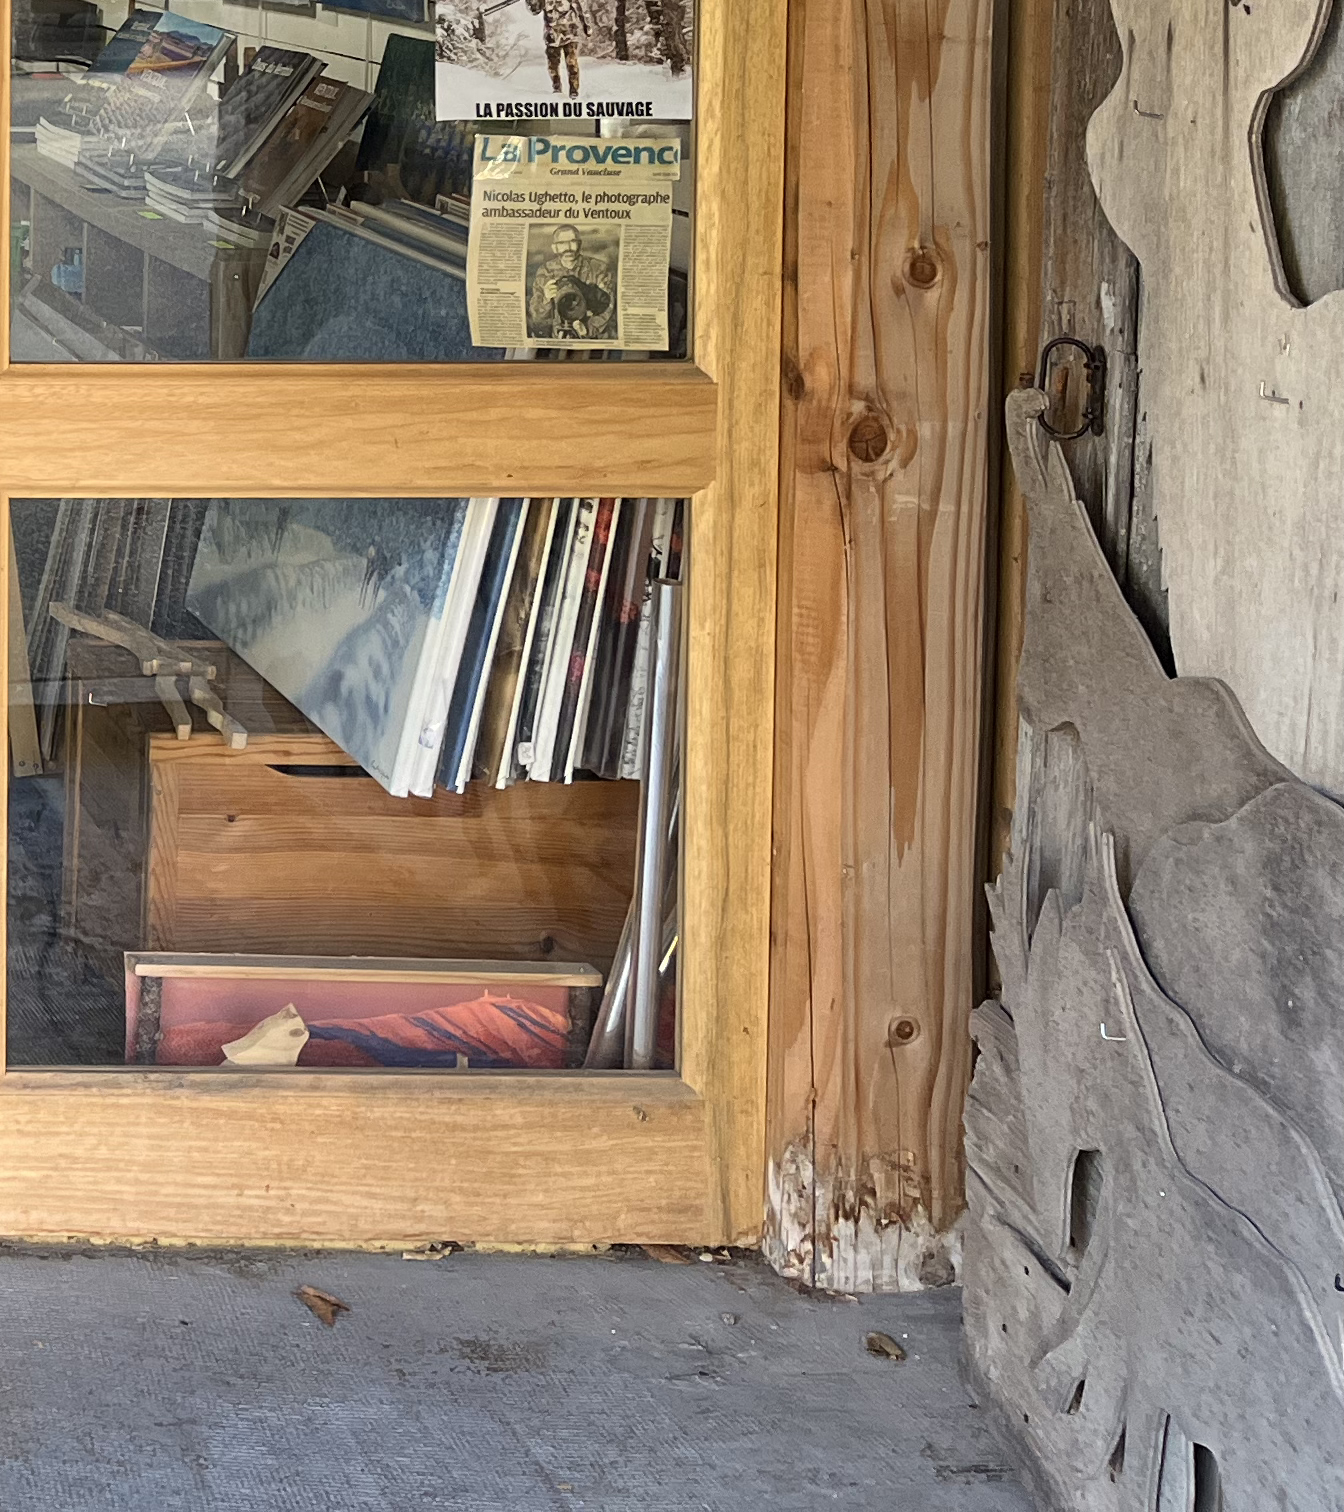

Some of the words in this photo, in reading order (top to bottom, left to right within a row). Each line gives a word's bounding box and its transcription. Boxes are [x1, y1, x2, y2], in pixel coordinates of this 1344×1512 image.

[476, 103, 492, 118] LA
[496, 102, 559, 118] PASSION
[562, 102, 583, 117] DU
[586, 101, 653, 117] SAUVAGE
[480, 137, 522, 163] La
[549, 167, 579, 176] Grand
[581, 167, 622, 176] Vaucluse
[482, 190, 526, 203] Nicolas
[528, 190, 579, 205] Ughetto,
[581, 190, 593, 203] le
[594, 191, 670, 206] photographe
[481, 206, 561, 219] ambassadeur
[564, 207, 580, 219] du
[582, 207, 632, 220] Ventoux
